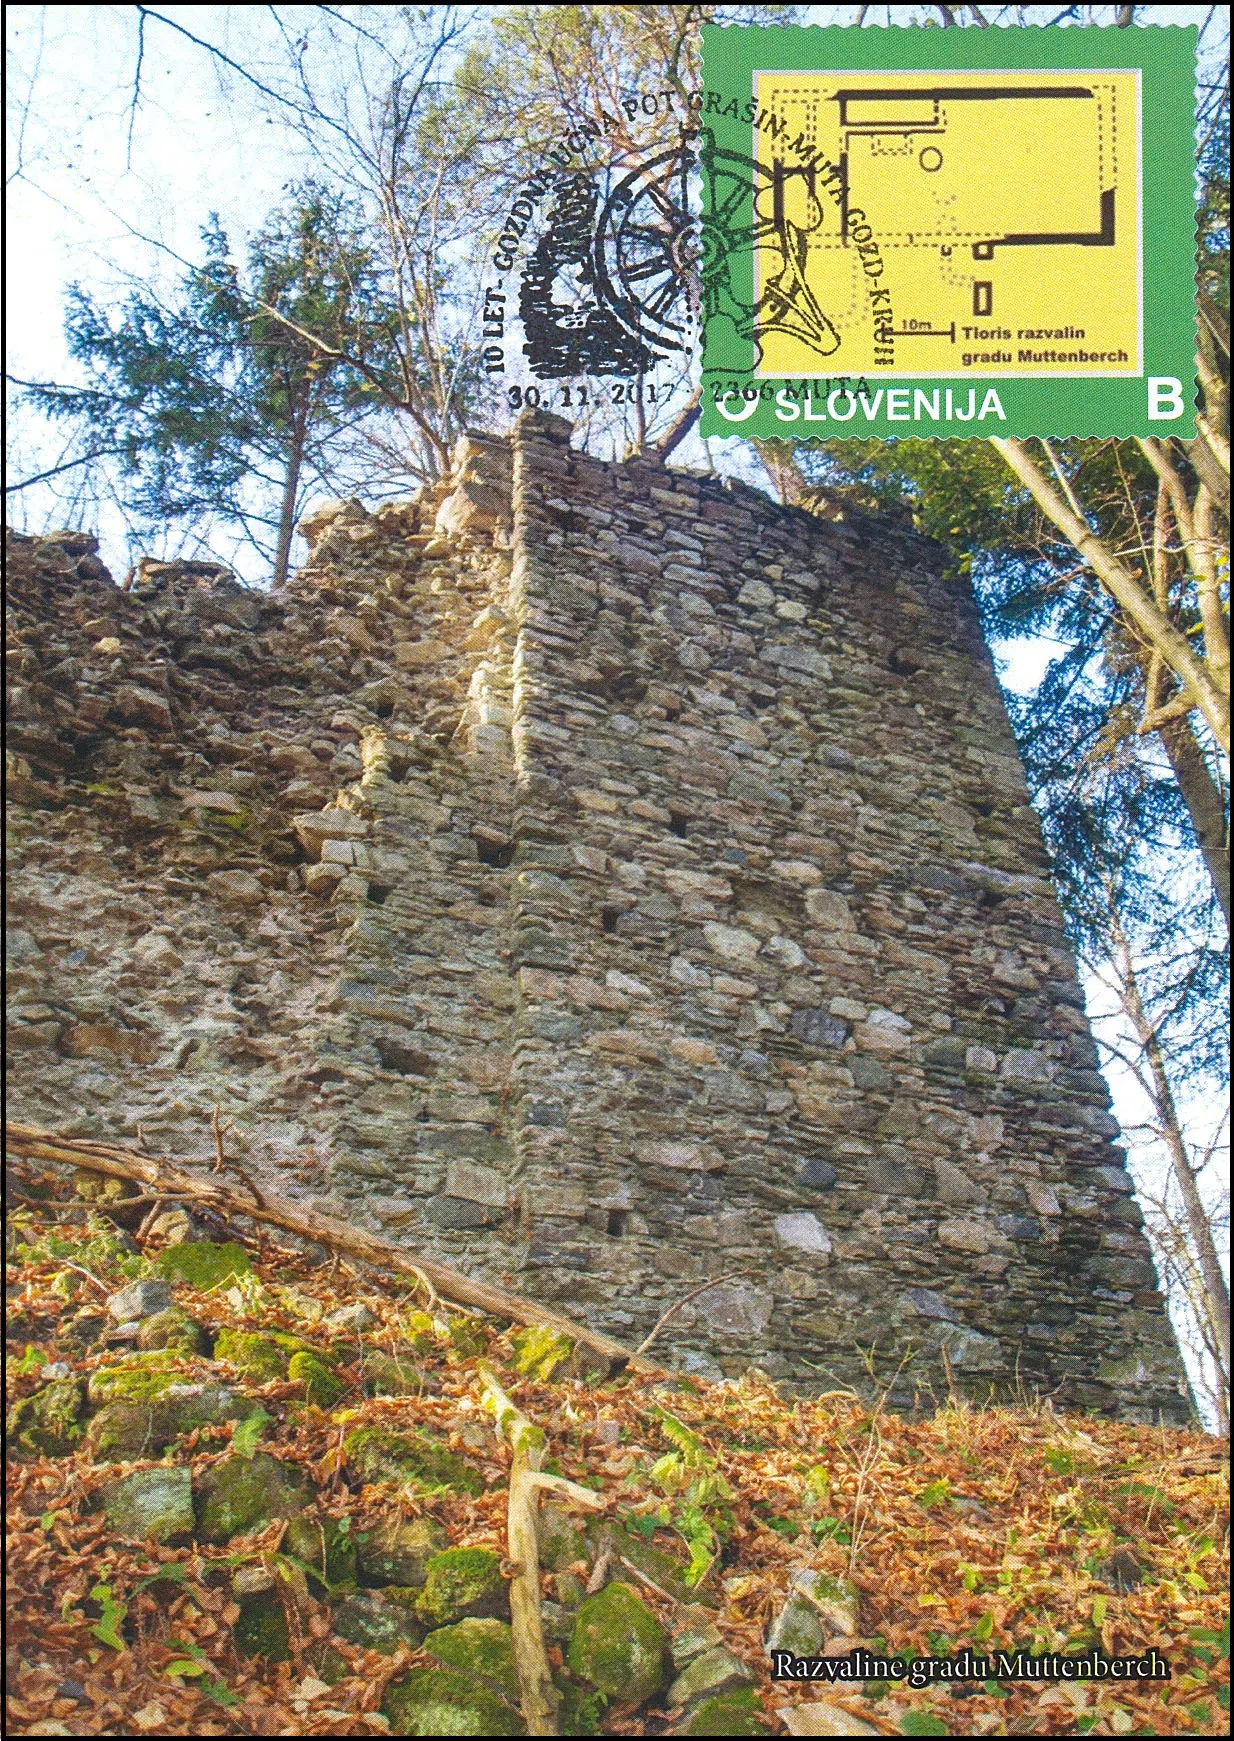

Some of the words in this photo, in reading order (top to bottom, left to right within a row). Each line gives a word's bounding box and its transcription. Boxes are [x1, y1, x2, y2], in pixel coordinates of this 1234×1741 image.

[483, 346, 505, 373] 10
[494, 169, 557, 271] GOZDNA
[622, 91, 676, 121] POT
[902, 319, 932, 330] 10m
[961, 326, 1012, 340] Tloris
[1017, 326, 1085, 340] razvalin
[961, 350, 1012, 367] gradu
[1017, 350, 1128, 364] Muttenberch
[611, 384, 676, 405] 2017
[710, 380, 775, 402] 2366
[784, 377, 873, 401] MUTA
[775, 388, 1007, 422] SLOVENIJA
[1147, 377, 1184, 420] B
